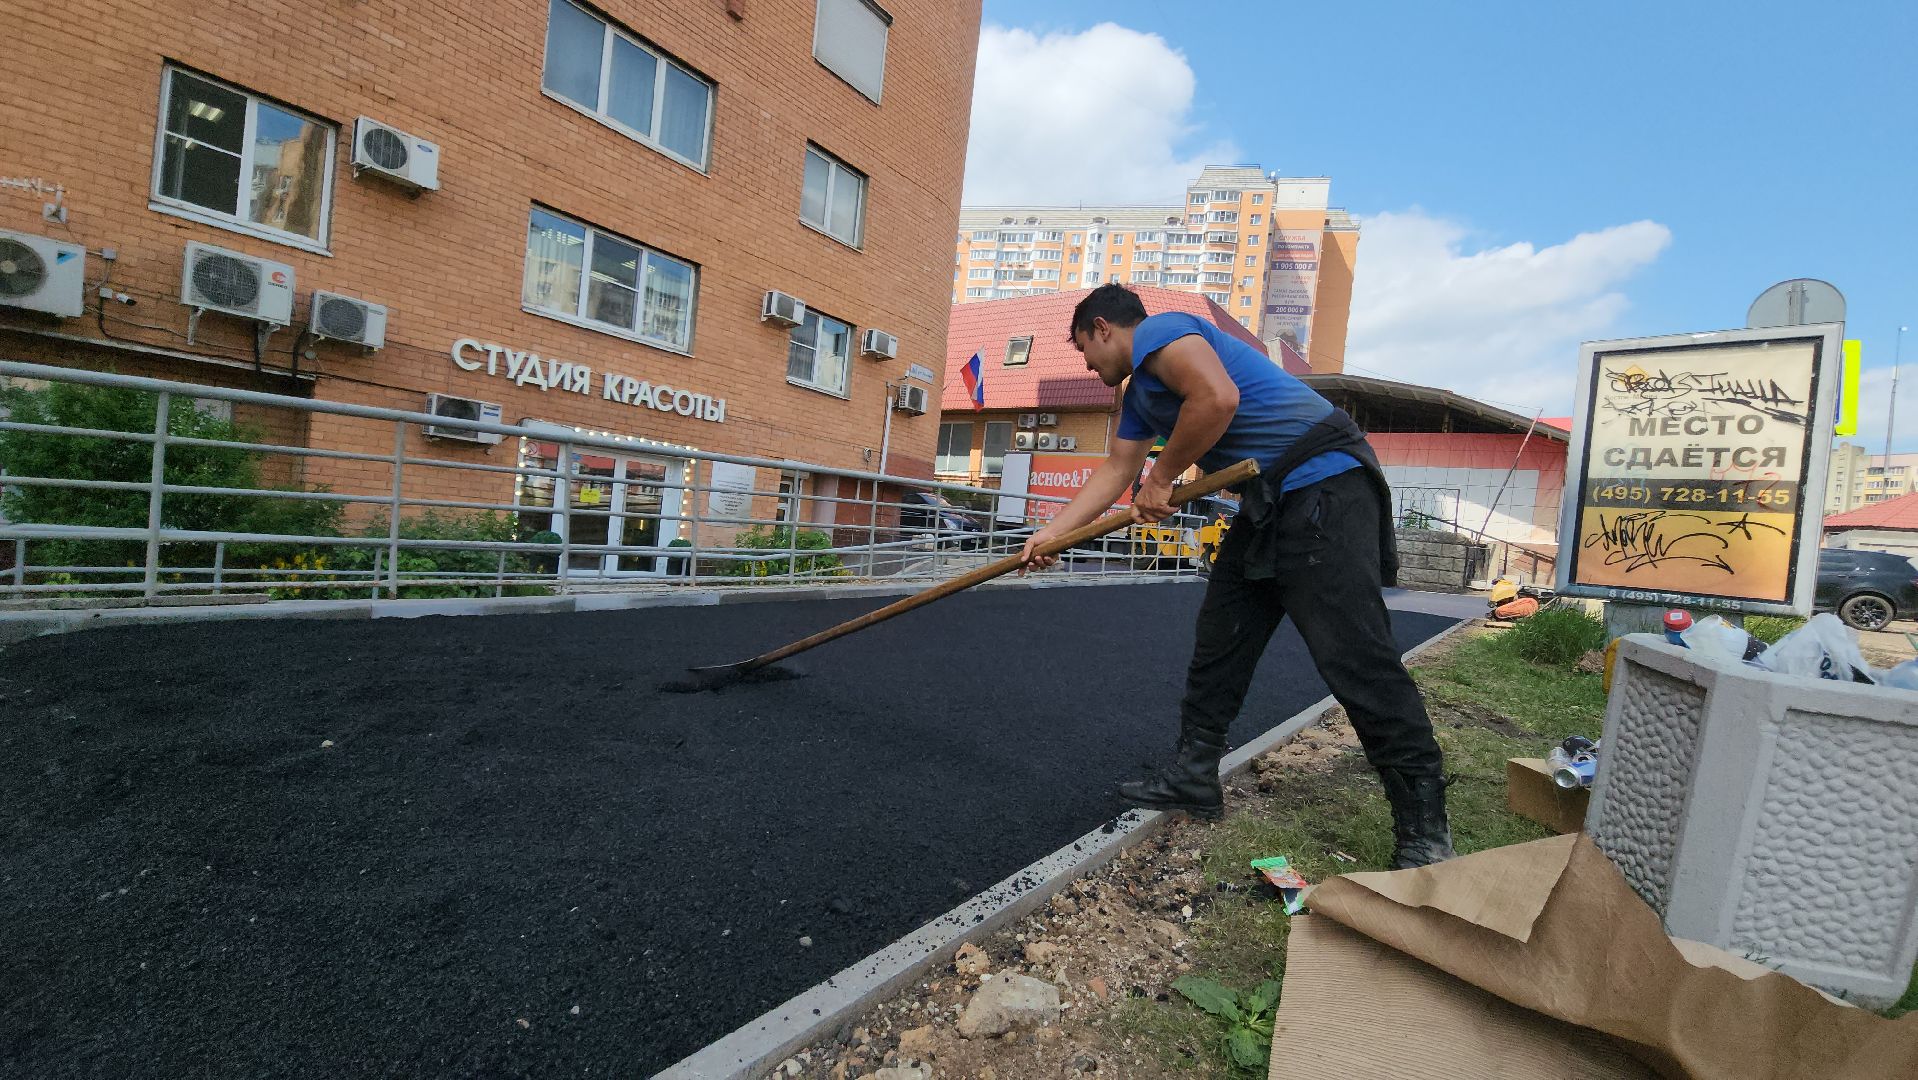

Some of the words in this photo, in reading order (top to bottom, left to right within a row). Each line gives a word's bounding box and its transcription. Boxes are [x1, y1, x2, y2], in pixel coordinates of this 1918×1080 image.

[452, 338, 591, 395] СТУДИЯ
[603, 373, 726, 423] КРАСОТЫ
[1628, 414, 1764, 437] МЕСТО
[1603, 444, 1787, 471] СДАЁТСЯ
[1592, 486, 1651, 504] (495)
[1660, 487, 1790, 505] 728-11-55
[1608, 589, 1616, 598] 8
[1622, 589, 1659, 602] (495)
